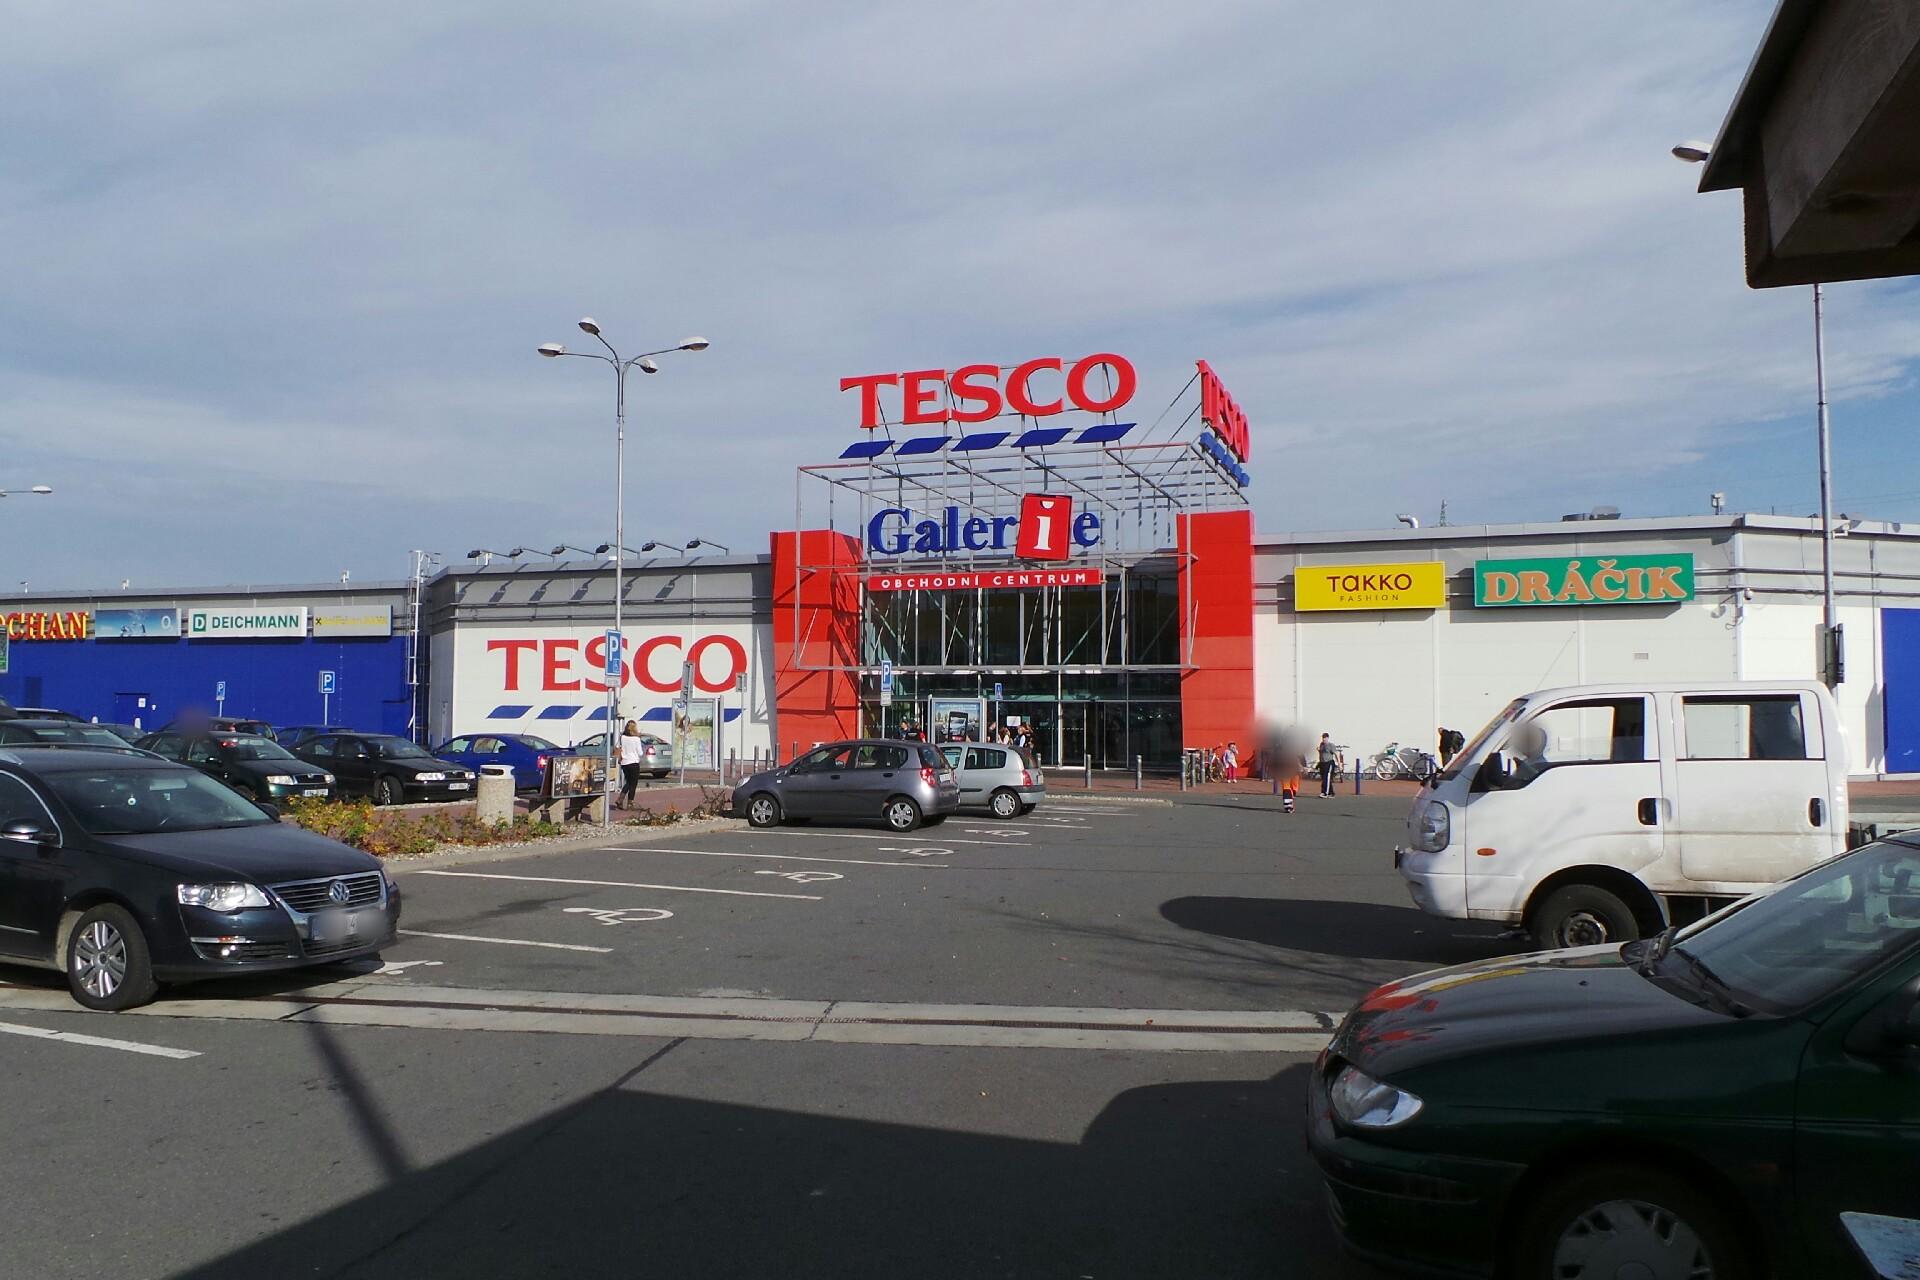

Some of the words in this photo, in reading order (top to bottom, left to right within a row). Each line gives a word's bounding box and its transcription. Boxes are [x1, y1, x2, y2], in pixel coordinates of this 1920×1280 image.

[839, 353, 1136, 428] TESCO
[867, 499, 1101, 555] Galerie
[881, 575, 979, 589] OBCHODNÍ
[993, 573, 1086, 586] CENTRUM
[1484, 560, 1687, 602] DRÁČIK
[1339, 594, 1399, 602] FASHION
[0, 611, 89, 640] CHAN
[212, 615, 299, 629] DEICHMANN
[609, 635, 619, 662] P
[487, 635, 748, 693] TESCO
[883, 664, 890, 683] P
[324, 674, 332, 687] P
